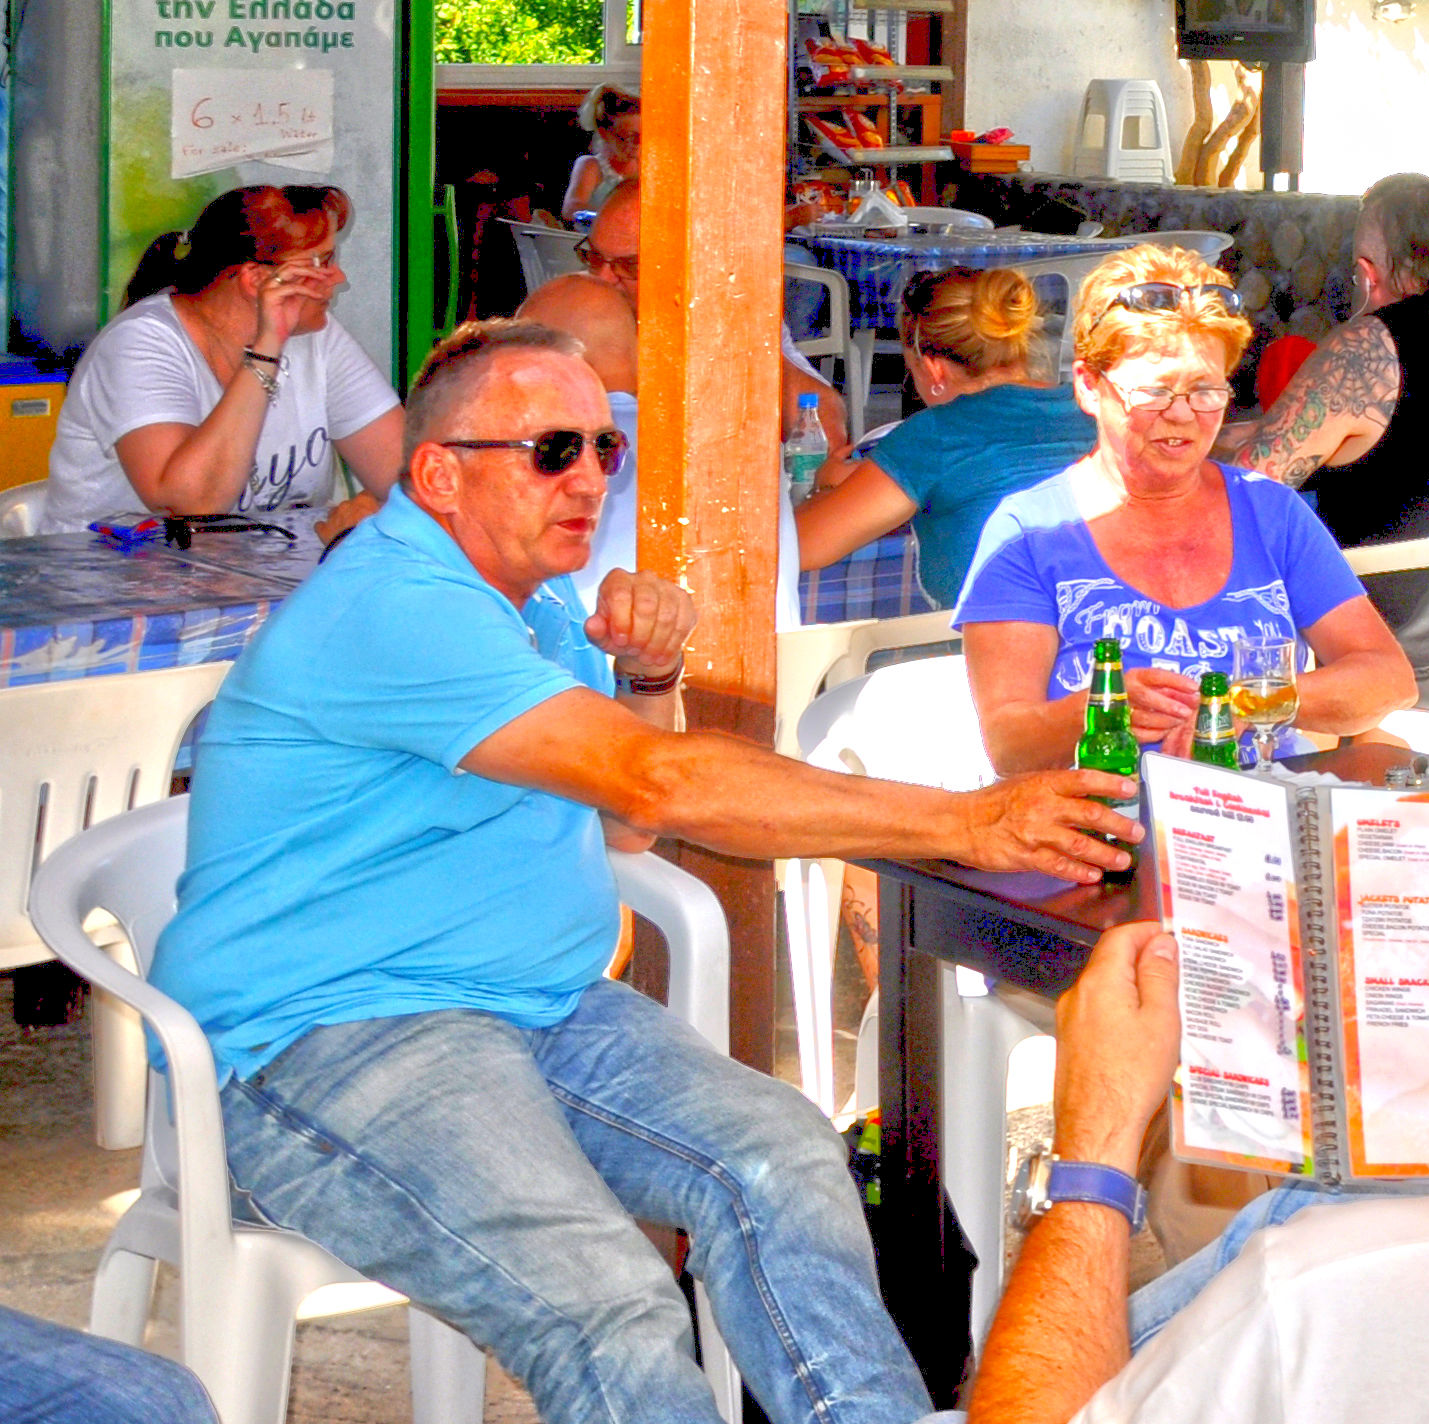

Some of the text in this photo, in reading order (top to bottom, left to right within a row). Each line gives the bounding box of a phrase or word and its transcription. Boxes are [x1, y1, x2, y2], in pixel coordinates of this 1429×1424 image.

[155, 26, 355, 54] που Αγαπάμε
[191, 97, 214, 129] 6
